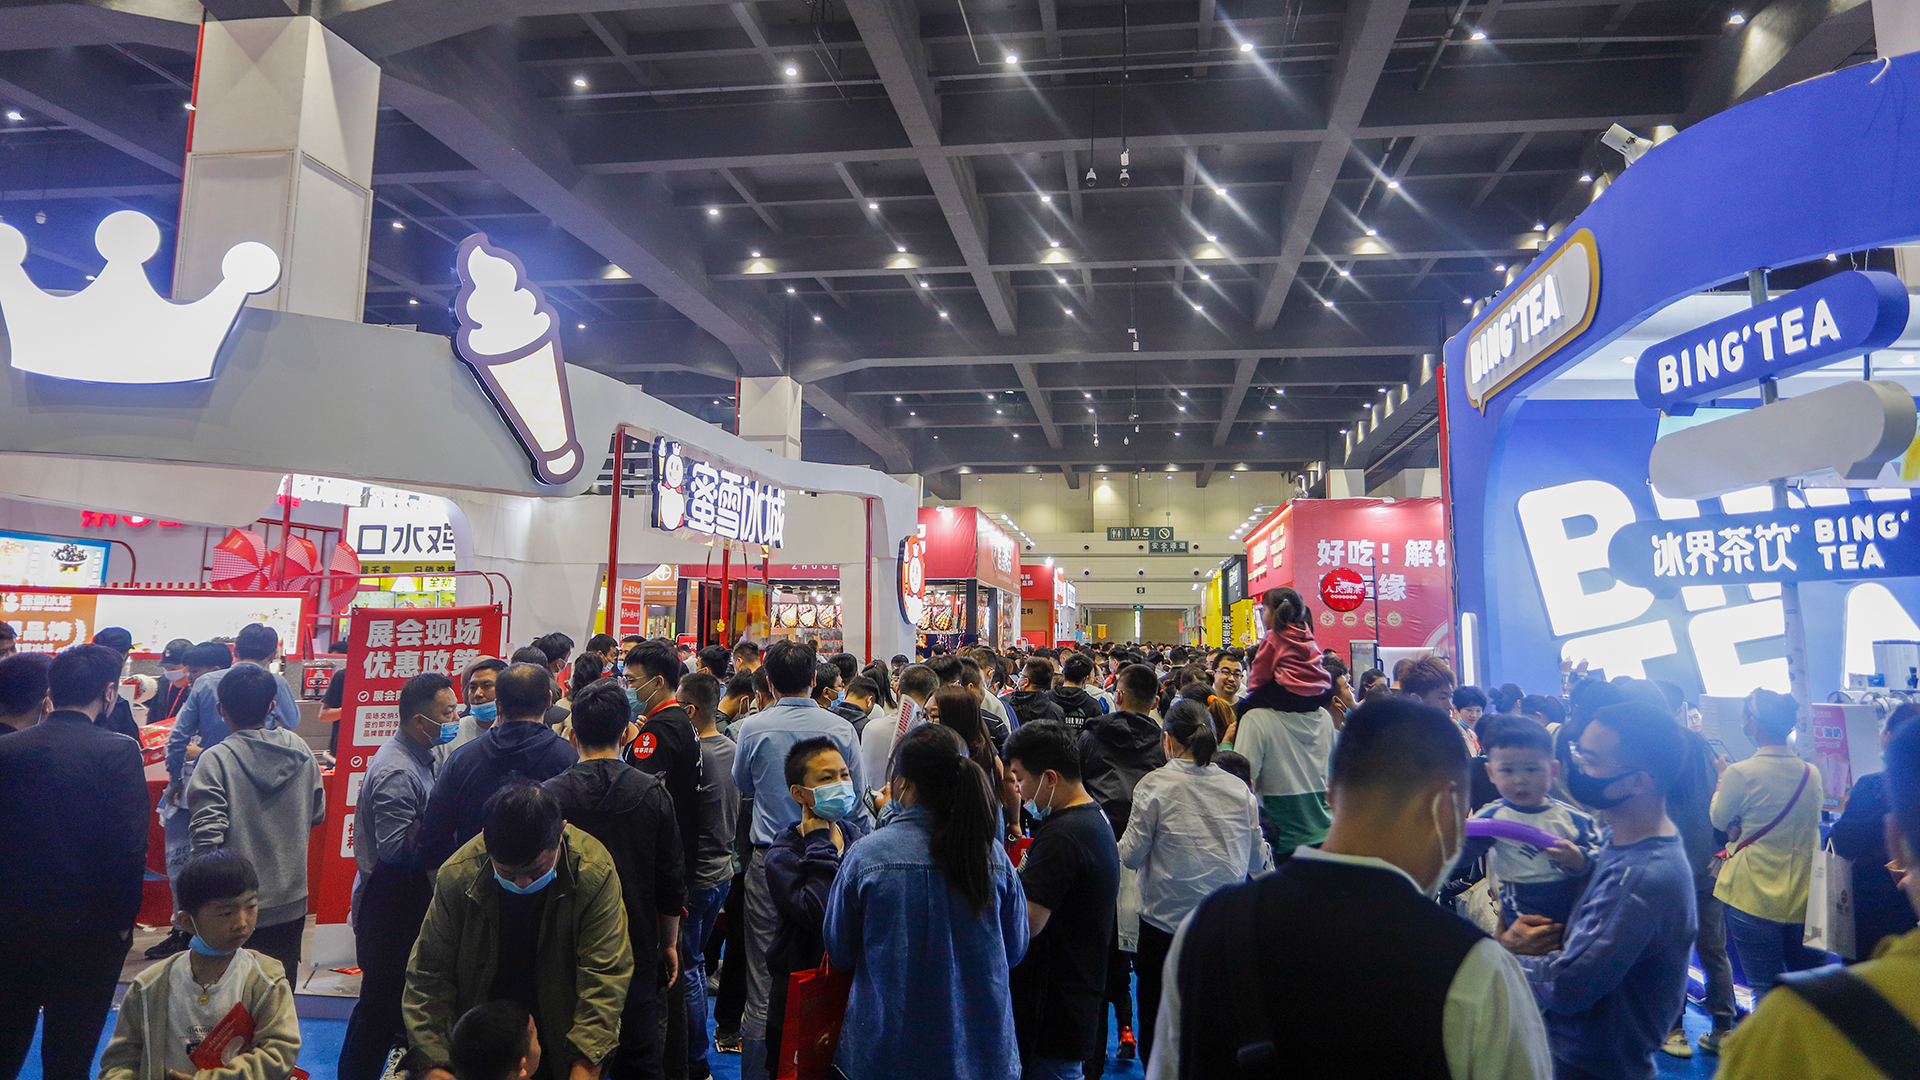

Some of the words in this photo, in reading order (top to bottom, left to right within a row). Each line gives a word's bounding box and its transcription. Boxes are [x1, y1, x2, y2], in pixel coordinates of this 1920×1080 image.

[688, 461, 785, 549] 蜜雪冰城
[1813, 510, 1910, 543] BING'
[1651, 523, 1798, 577] 冰界茶饮
[1816, 542, 1886, 571] TEA
[366, 617, 483, 648] 展会现场
[363, 649, 481, 679] 优惠政策
